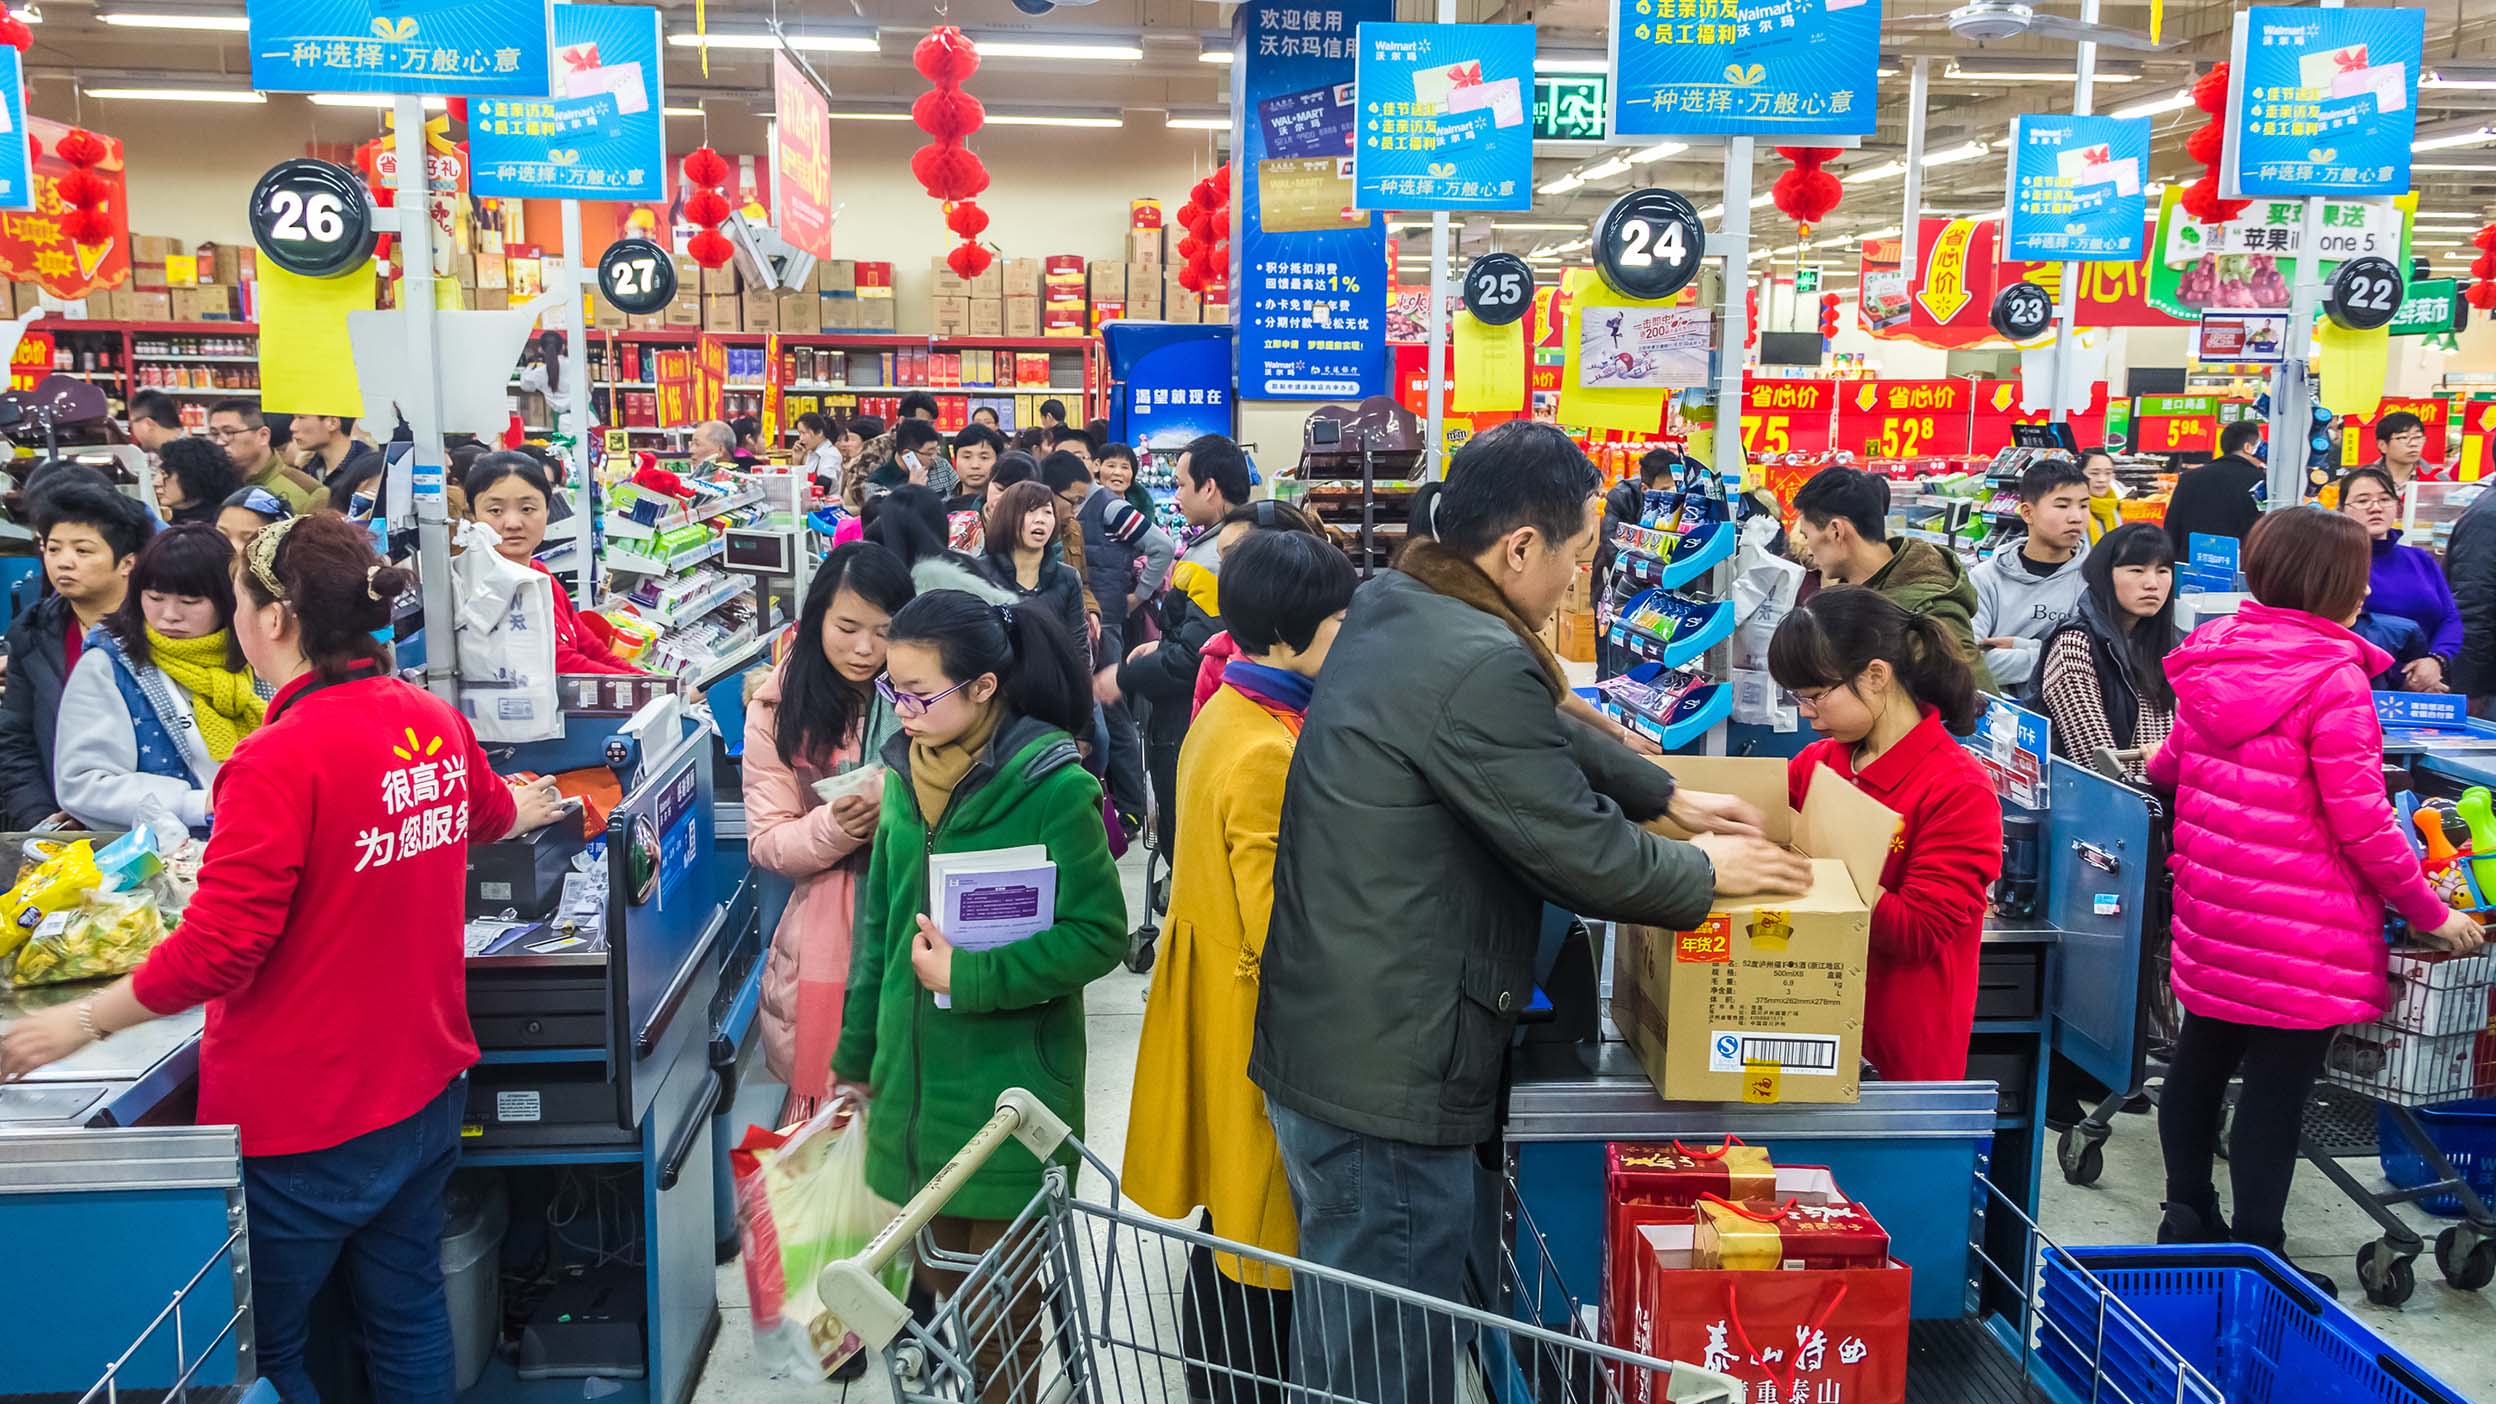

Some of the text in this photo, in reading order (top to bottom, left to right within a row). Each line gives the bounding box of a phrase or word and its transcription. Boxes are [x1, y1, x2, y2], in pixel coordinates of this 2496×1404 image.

[1260, 8, 1343, 31] 欢迎使用
[1656, 0, 1739, 19] 走亲访友
[1654, 23, 1737, 45] 员工福利
[1736, 14, 1795, 38] 沃尔玛
[1375, 39, 1417, 51] Walmart
[1375, 50, 1417, 61] 沃尔玛
[270, 191, 344, 241] 26
[1620, 219, 1686, 268] 24
[1936, 229, 1966, 294] 省心价
[611, 258, 655, 296] 27
[1478, 273, 1522, 306] 25
[2347, 276, 2392, 311] 22
[1264, 317, 1313, 330] 分期付款
[2010, 299, 2044, 324] 23
[1135, 389, 1223, 405] 渴望就现在
[1752, 385, 1819, 410] 省心价
[1888, 385, 1956, 410] 省心价
[381, 754, 467, 815] 很高兴
[1681, 936, 1726, 953] 年货2
